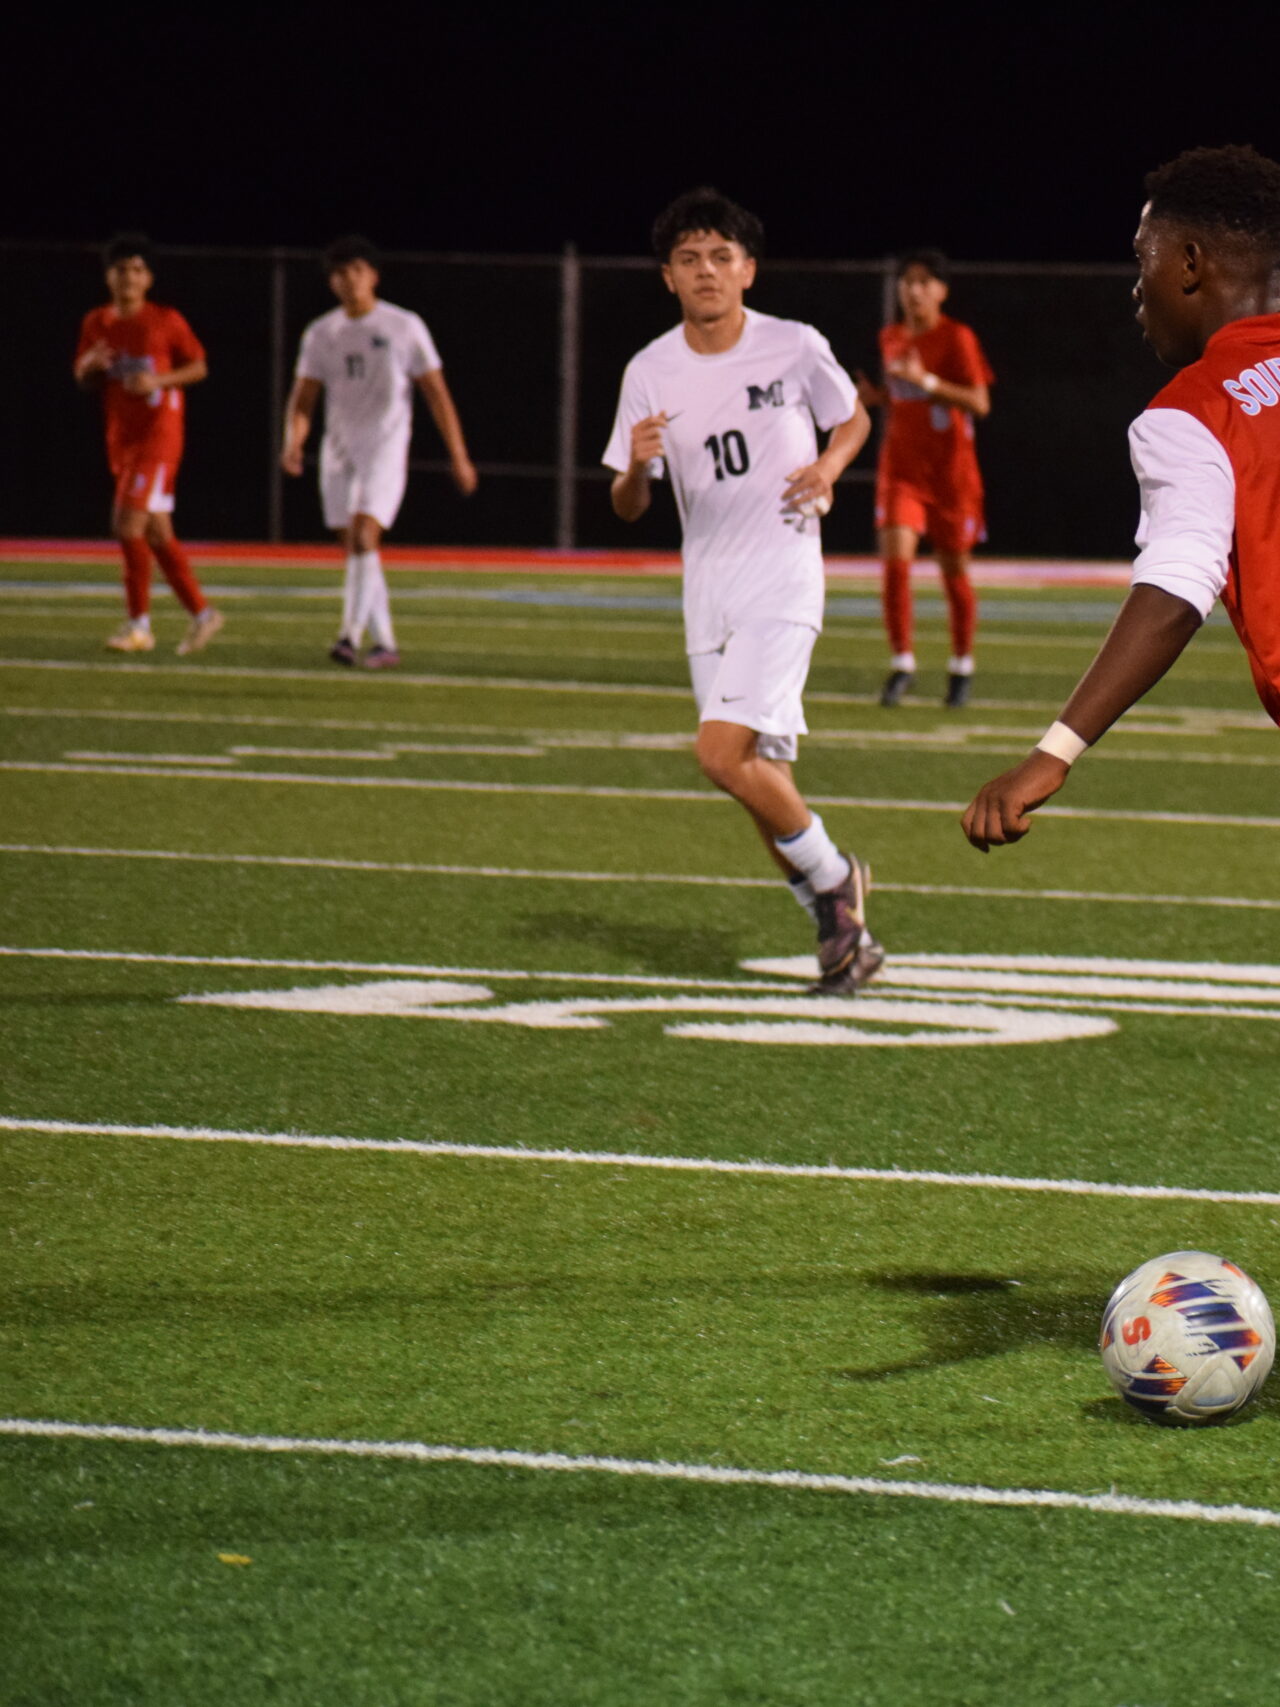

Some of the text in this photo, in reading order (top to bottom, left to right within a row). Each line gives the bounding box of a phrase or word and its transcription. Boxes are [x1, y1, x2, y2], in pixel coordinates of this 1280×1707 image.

[747, 379, 784, 411] M
[704, 430, 749, 482] 10
[1121, 1316, 1152, 1346] S
